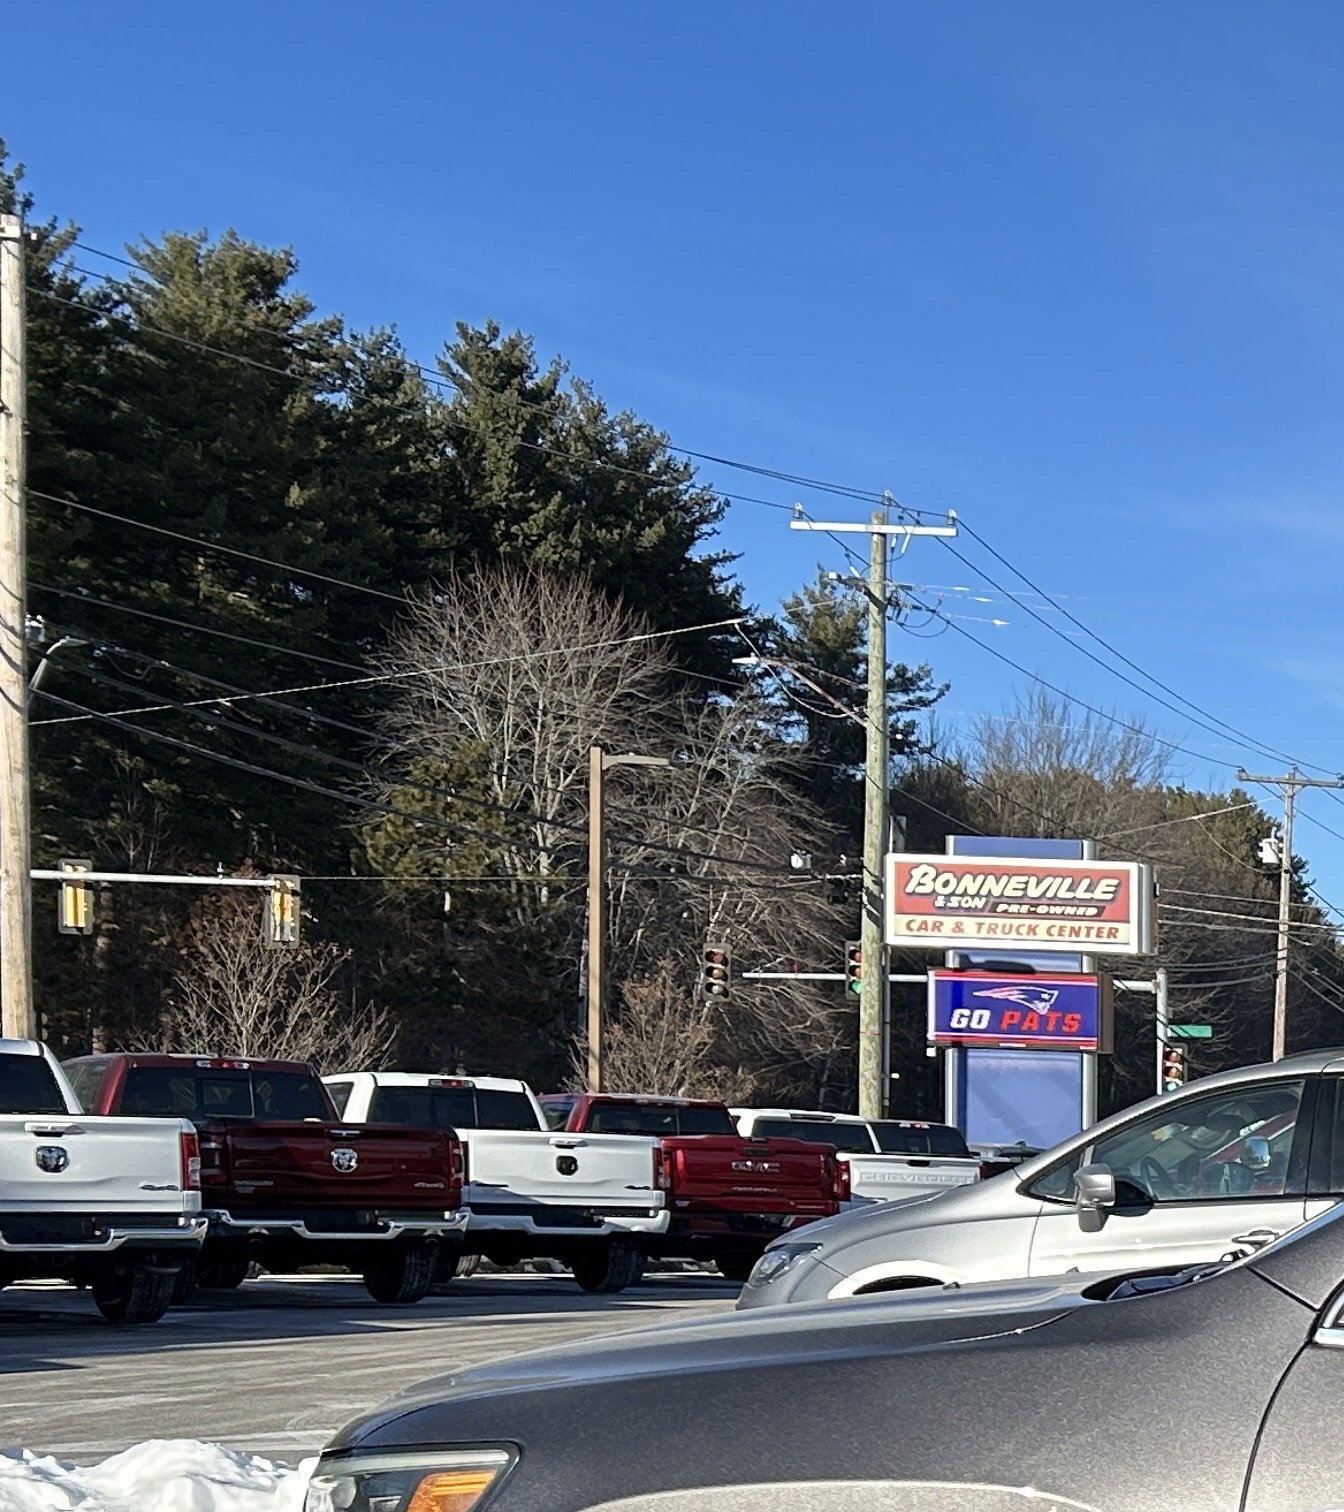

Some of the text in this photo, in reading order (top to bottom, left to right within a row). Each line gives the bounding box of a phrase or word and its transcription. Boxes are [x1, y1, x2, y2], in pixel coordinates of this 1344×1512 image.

[905, 864, 1119, 900] BONNEVILLE
[996, 904, 1098, 917] PRE-OWNED
[905, 919, 1119, 939] CAR & TRUCK CENTER
[950, 1009, 1082, 1033] GO PATS
